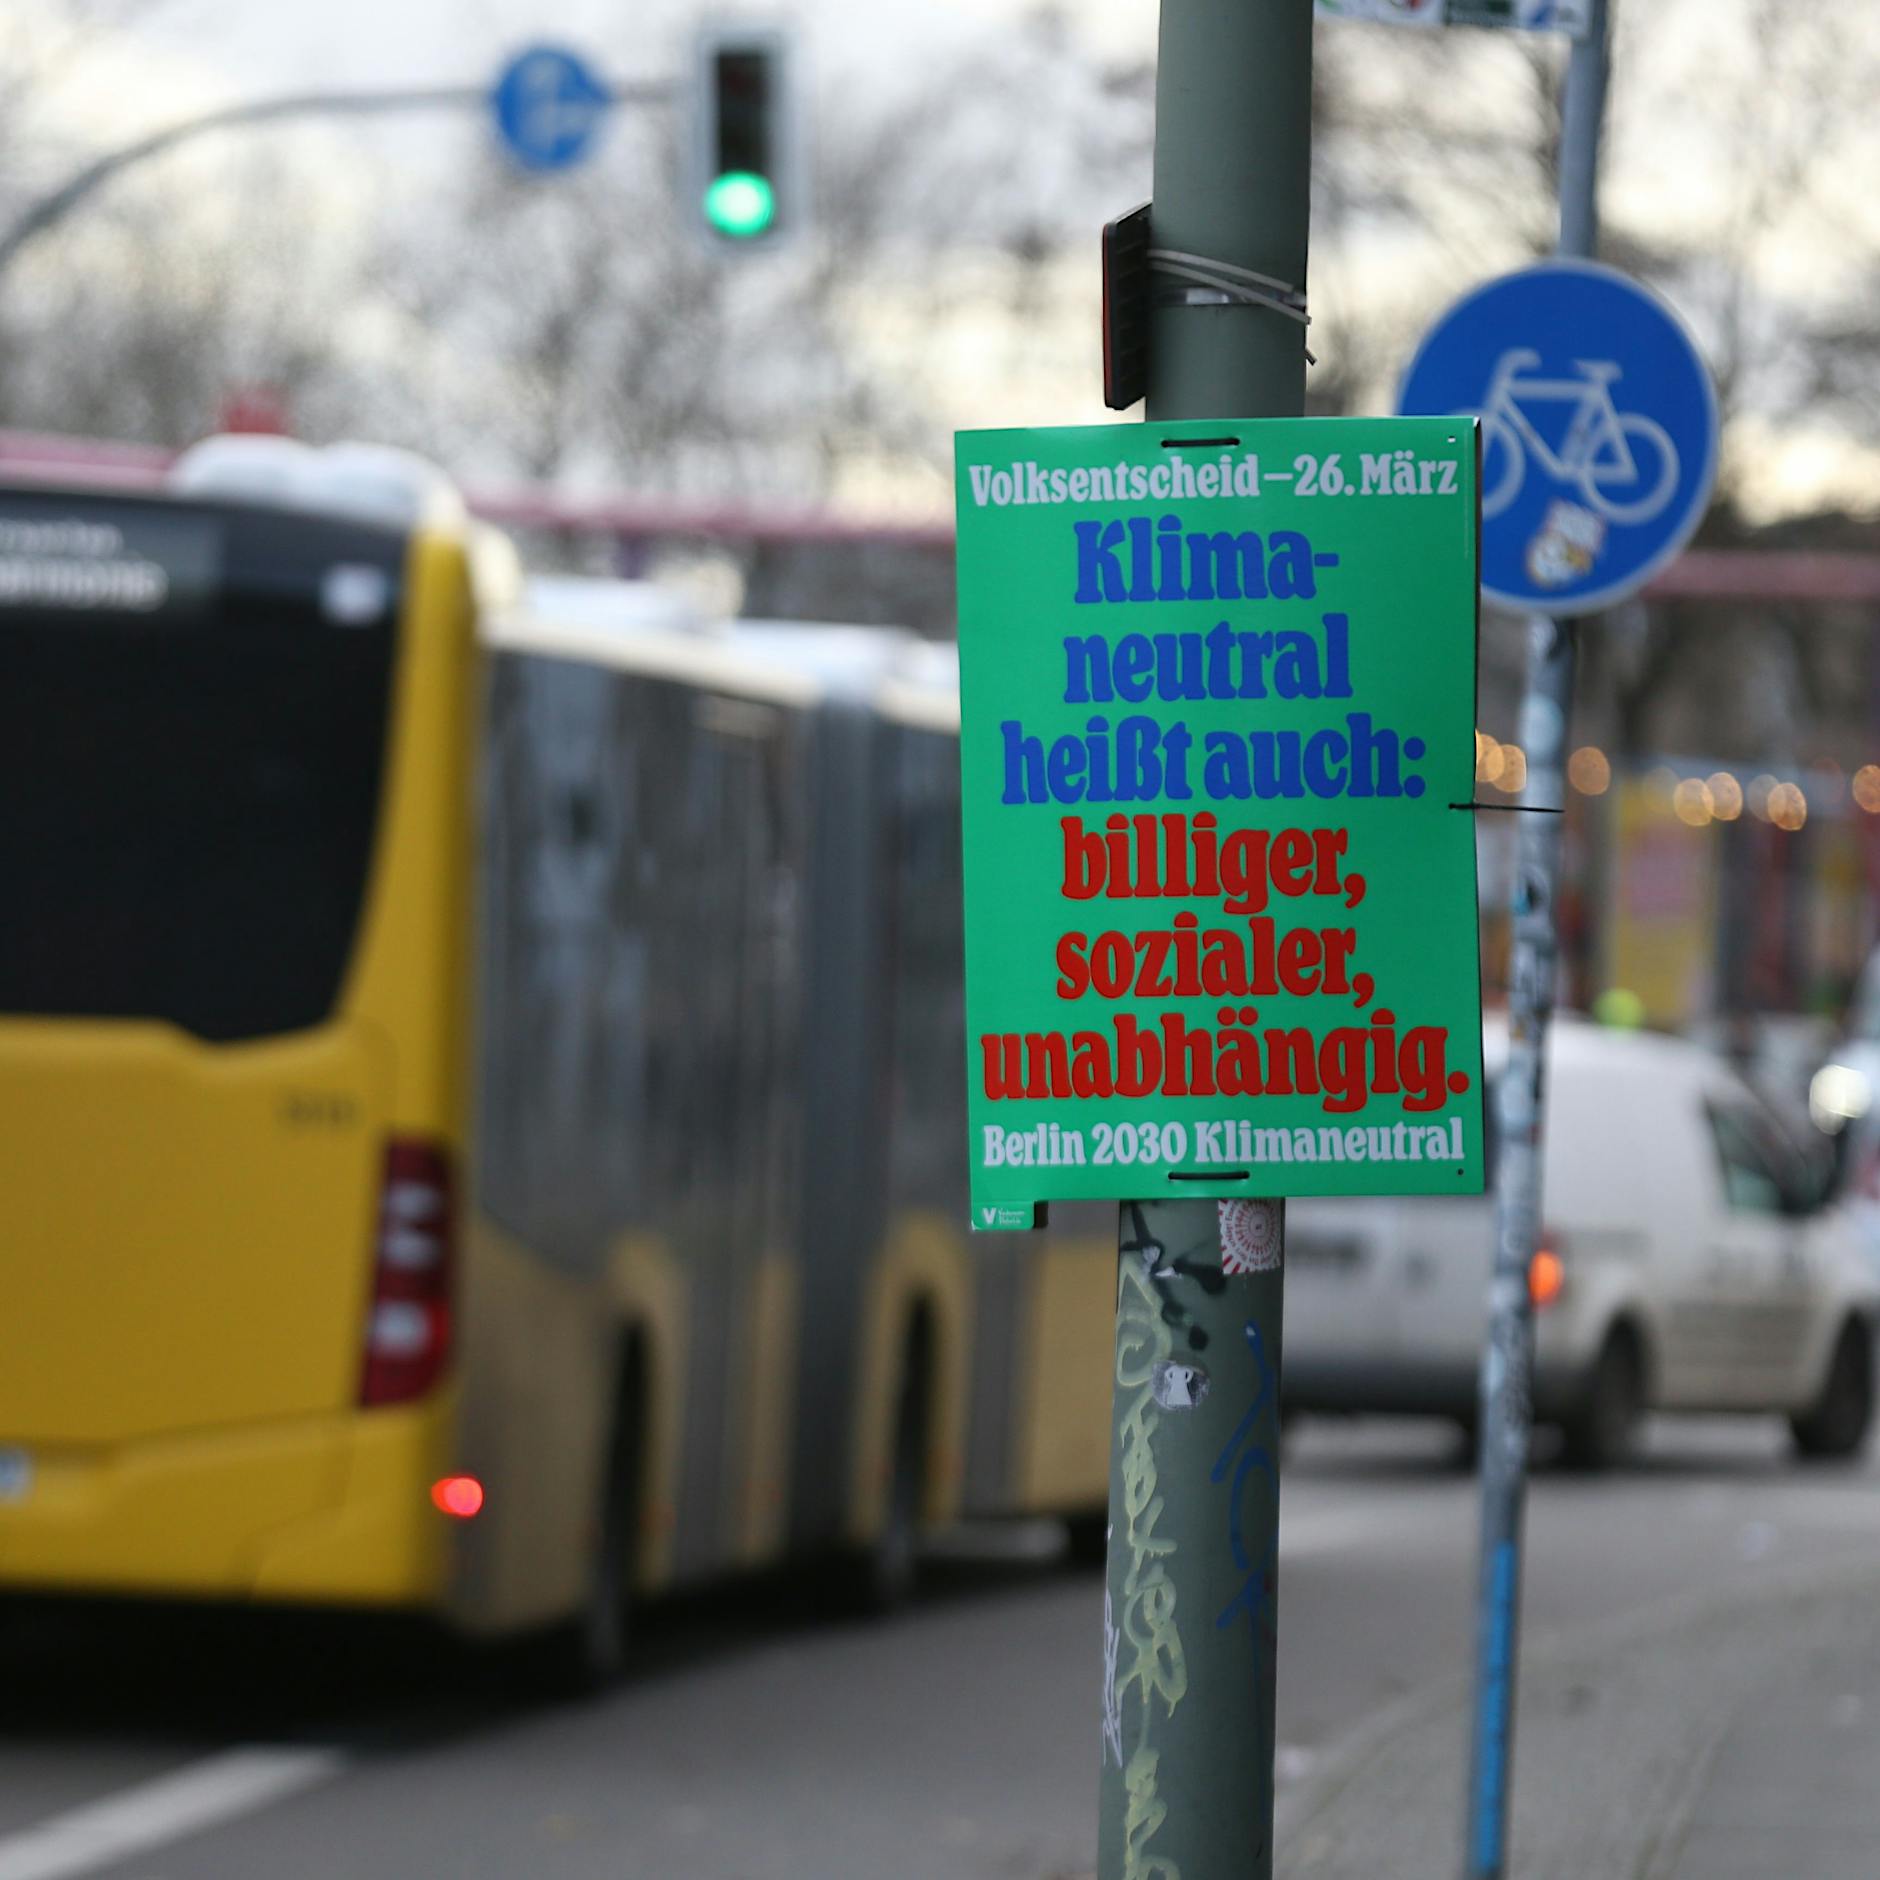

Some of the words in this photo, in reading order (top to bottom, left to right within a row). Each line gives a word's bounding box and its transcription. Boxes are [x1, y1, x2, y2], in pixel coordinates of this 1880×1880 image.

[969, 455, 1260, 506] Volksentscheid
[1360, 450, 1458, 495] März
[1074, 514, 1340, 604] Klima-
[1063, 612, 1354, 704] neutral
[1001, 715, 1193, 805] heißt
[1204, 712, 1426, 801] auch:
[1060, 811, 1366, 914] billiger,
[1056, 911, 1375, 1008] sozialer,
[981, 1006, 1469, 1113] unabhängig.
[983, 1122, 1087, 1167] Berlin
[1092, 1121, 1187, 1165] 2030
[1194, 1117, 1465, 1163] Klimaneutral
